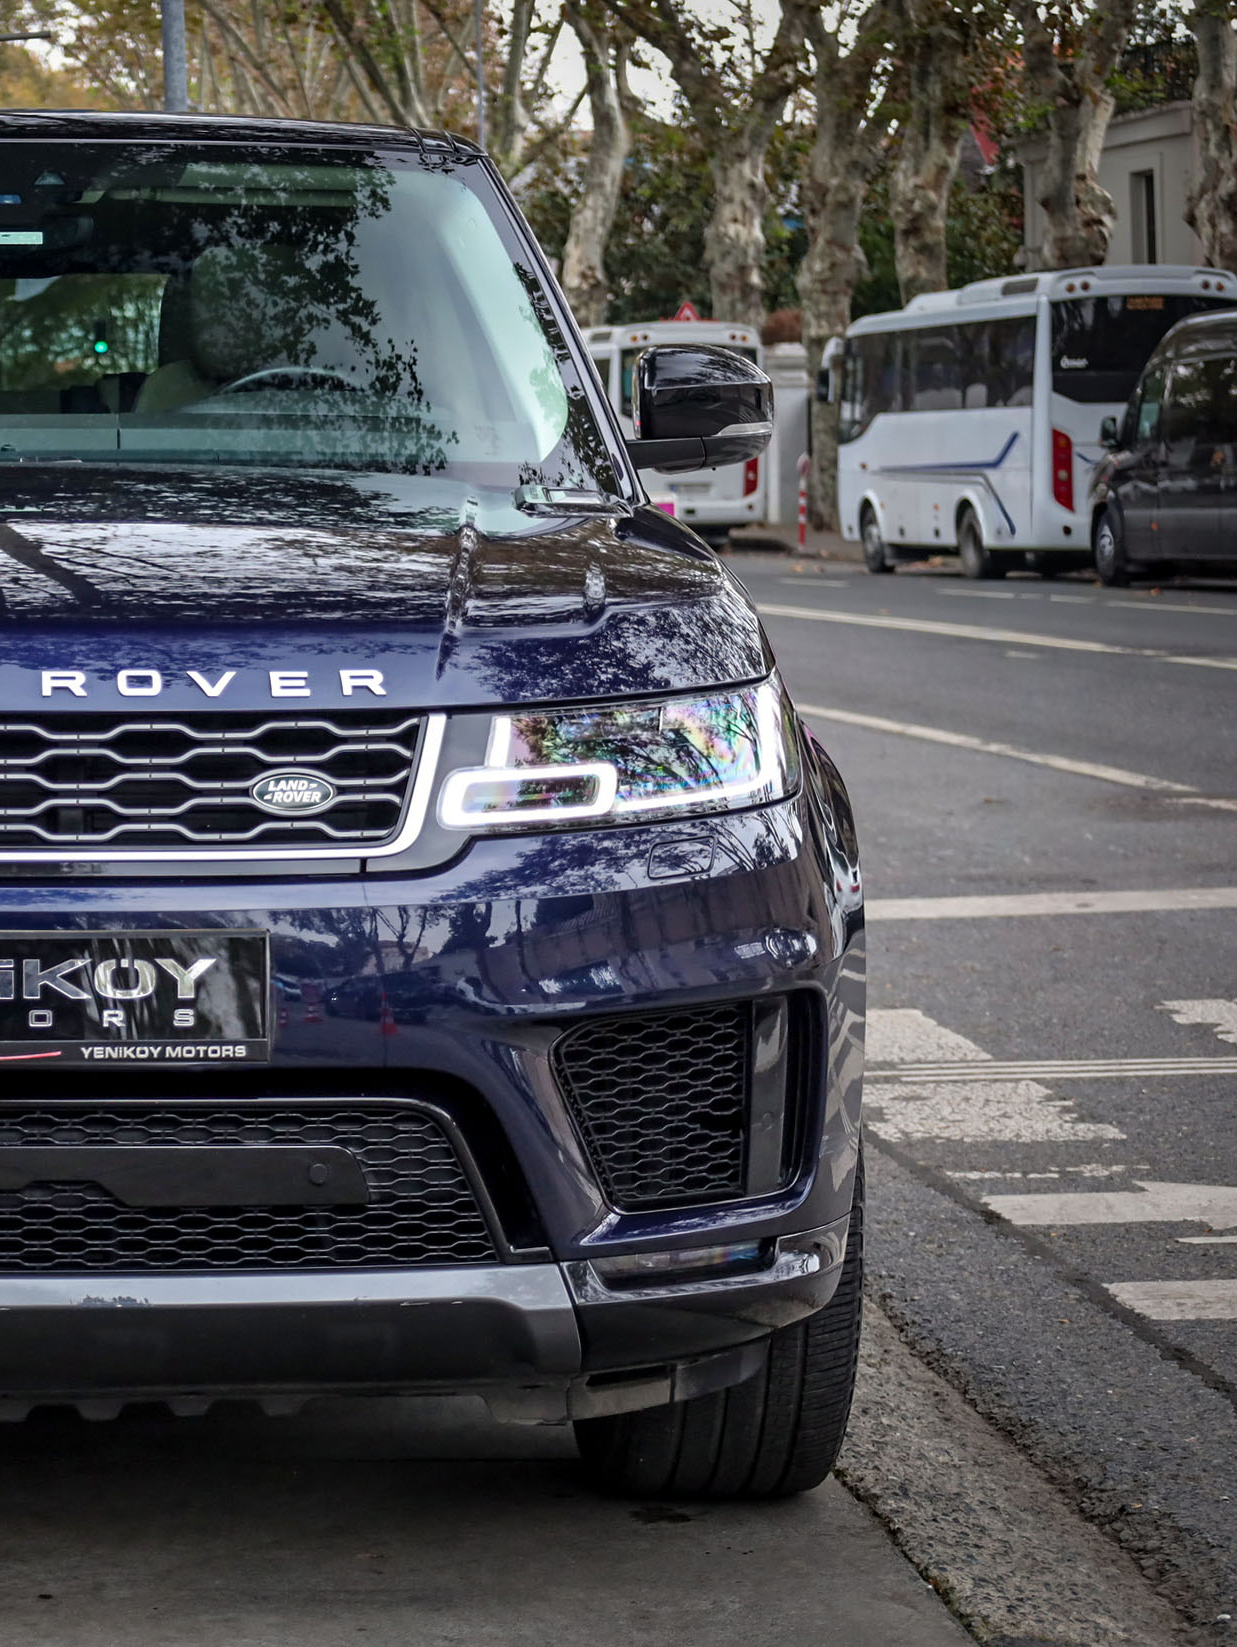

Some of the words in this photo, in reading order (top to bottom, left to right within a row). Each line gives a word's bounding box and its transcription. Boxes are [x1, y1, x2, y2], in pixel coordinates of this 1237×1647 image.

[41, 669, 387, 697] ROVER
[267, 780, 309, 791] LAND
[272, 791, 321, 803] ROVER
[165, 1045, 247, 1058] MOTORS
